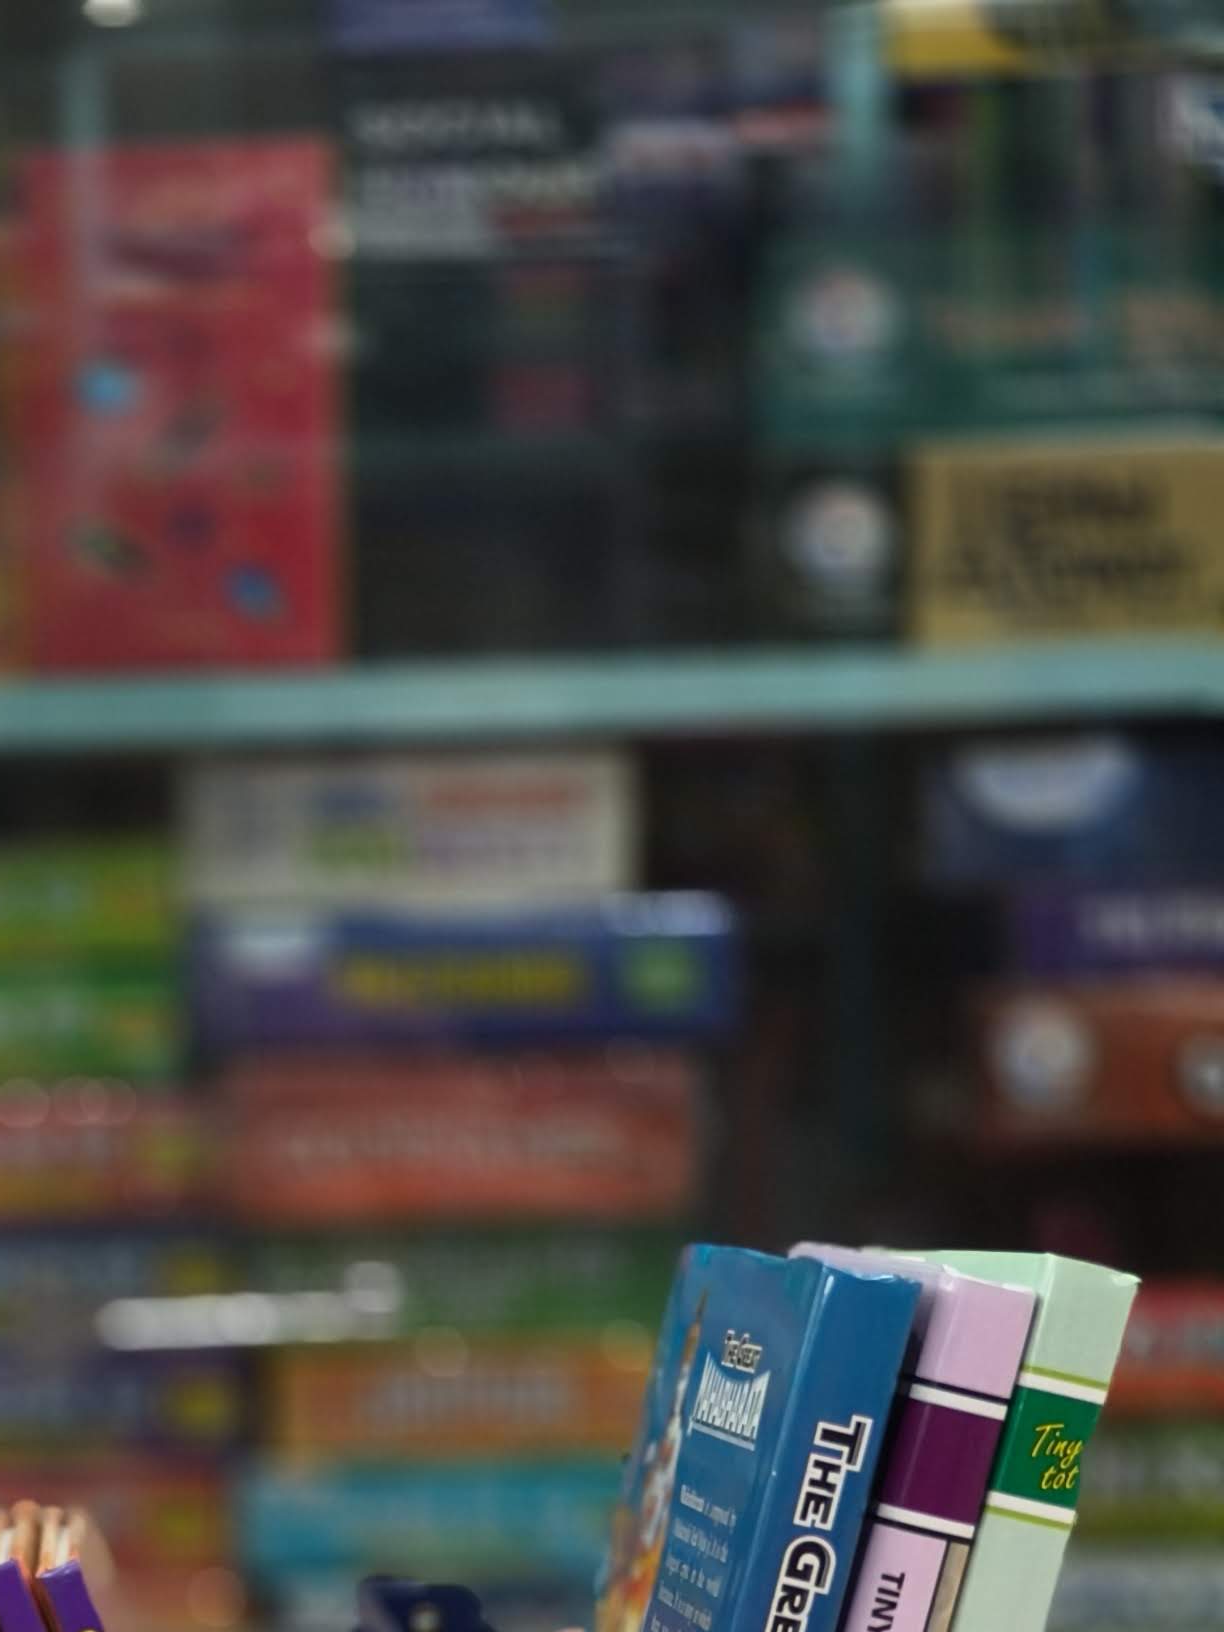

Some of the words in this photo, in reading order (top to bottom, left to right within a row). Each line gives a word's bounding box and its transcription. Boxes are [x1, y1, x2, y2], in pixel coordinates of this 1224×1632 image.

[1032, 1423, 1085, 1466] Tiny
[793, 1414, 873, 1530] THE
[1041, 1464, 1079, 1491] tot
